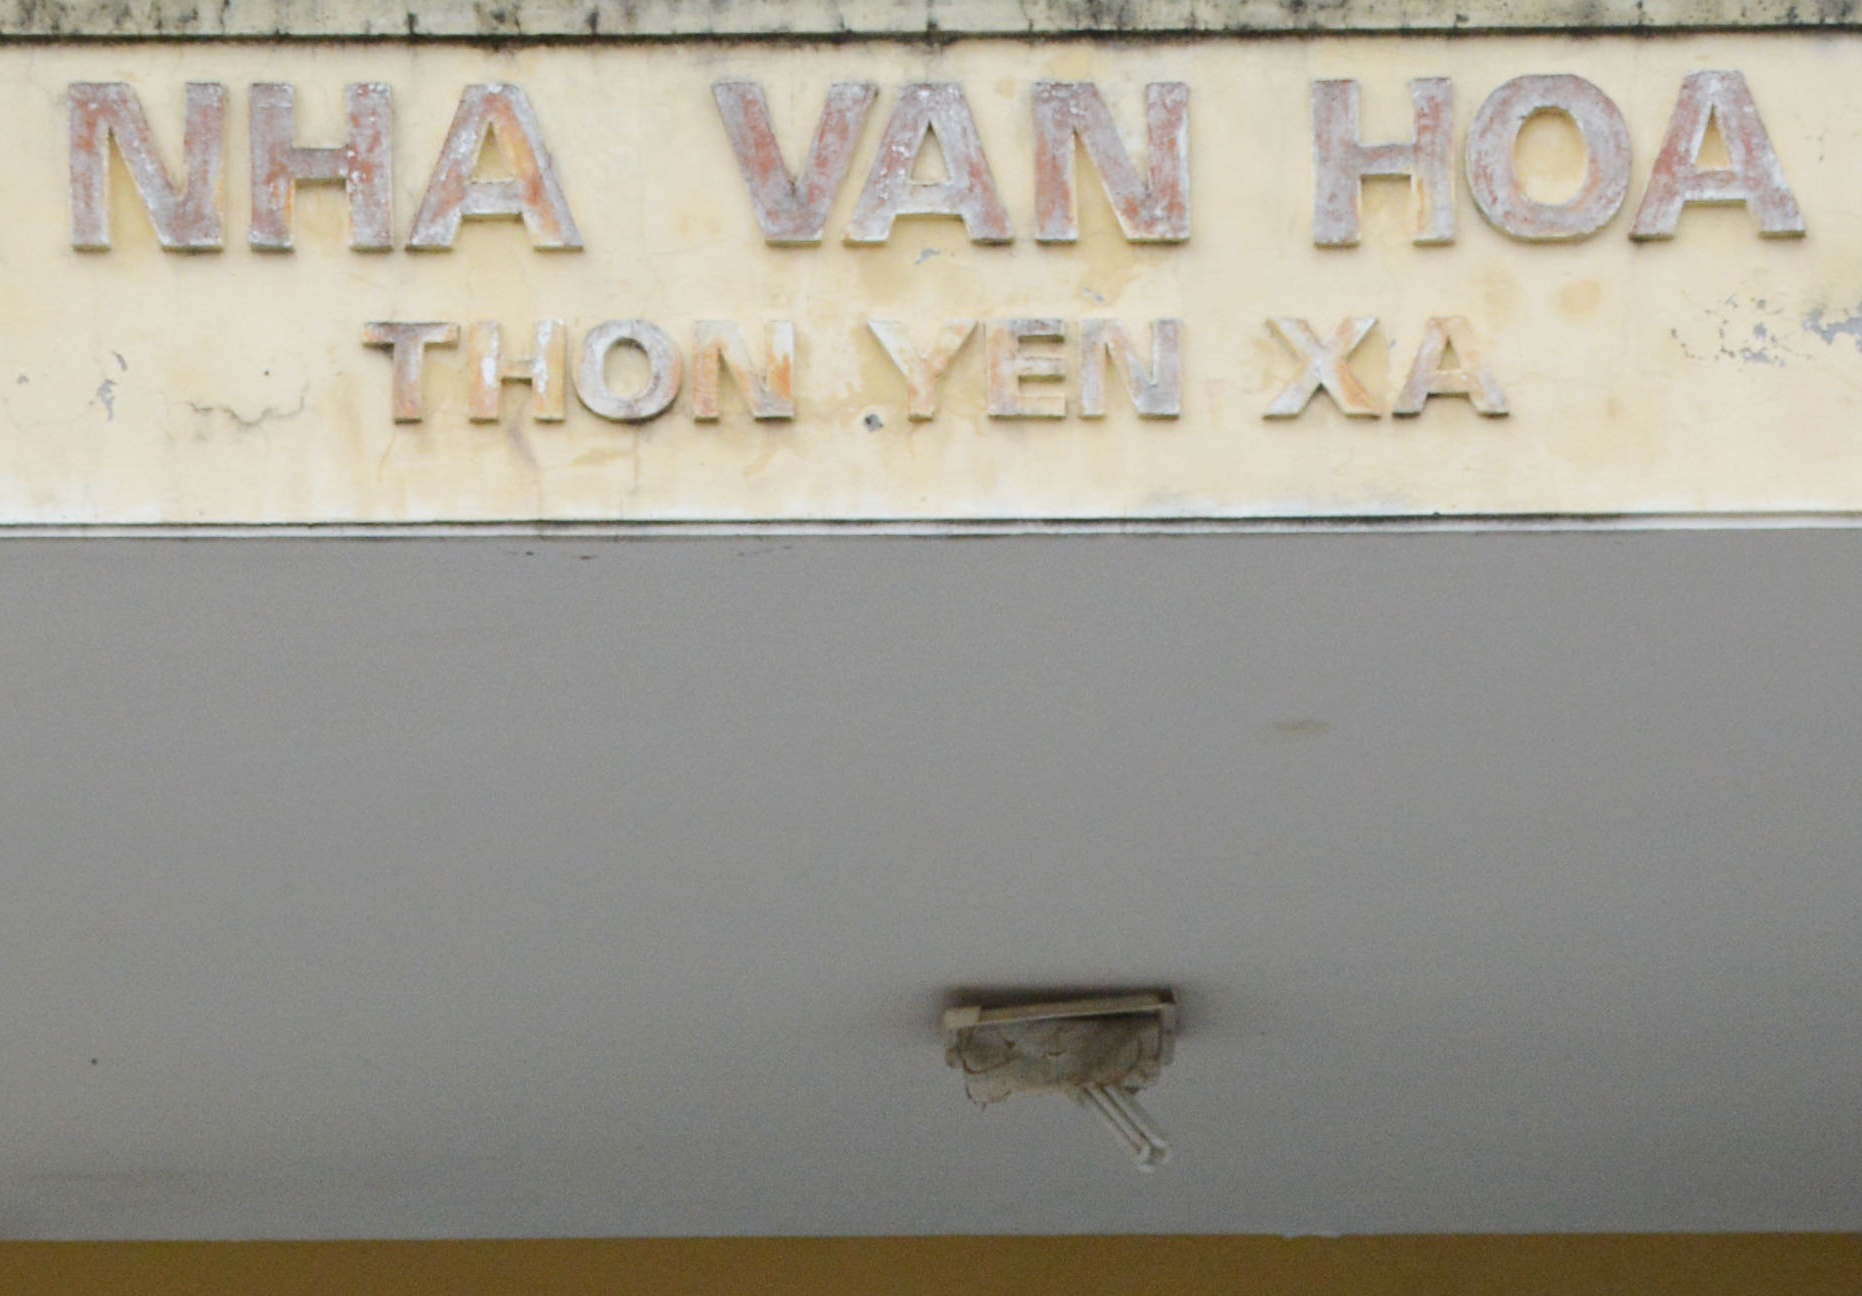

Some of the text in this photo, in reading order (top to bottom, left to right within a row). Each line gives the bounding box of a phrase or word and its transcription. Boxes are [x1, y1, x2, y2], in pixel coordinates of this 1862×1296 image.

[68, 69, 1807, 252] NHA VAN HOA
[363, 317, 1510, 422] THON YEN XA
